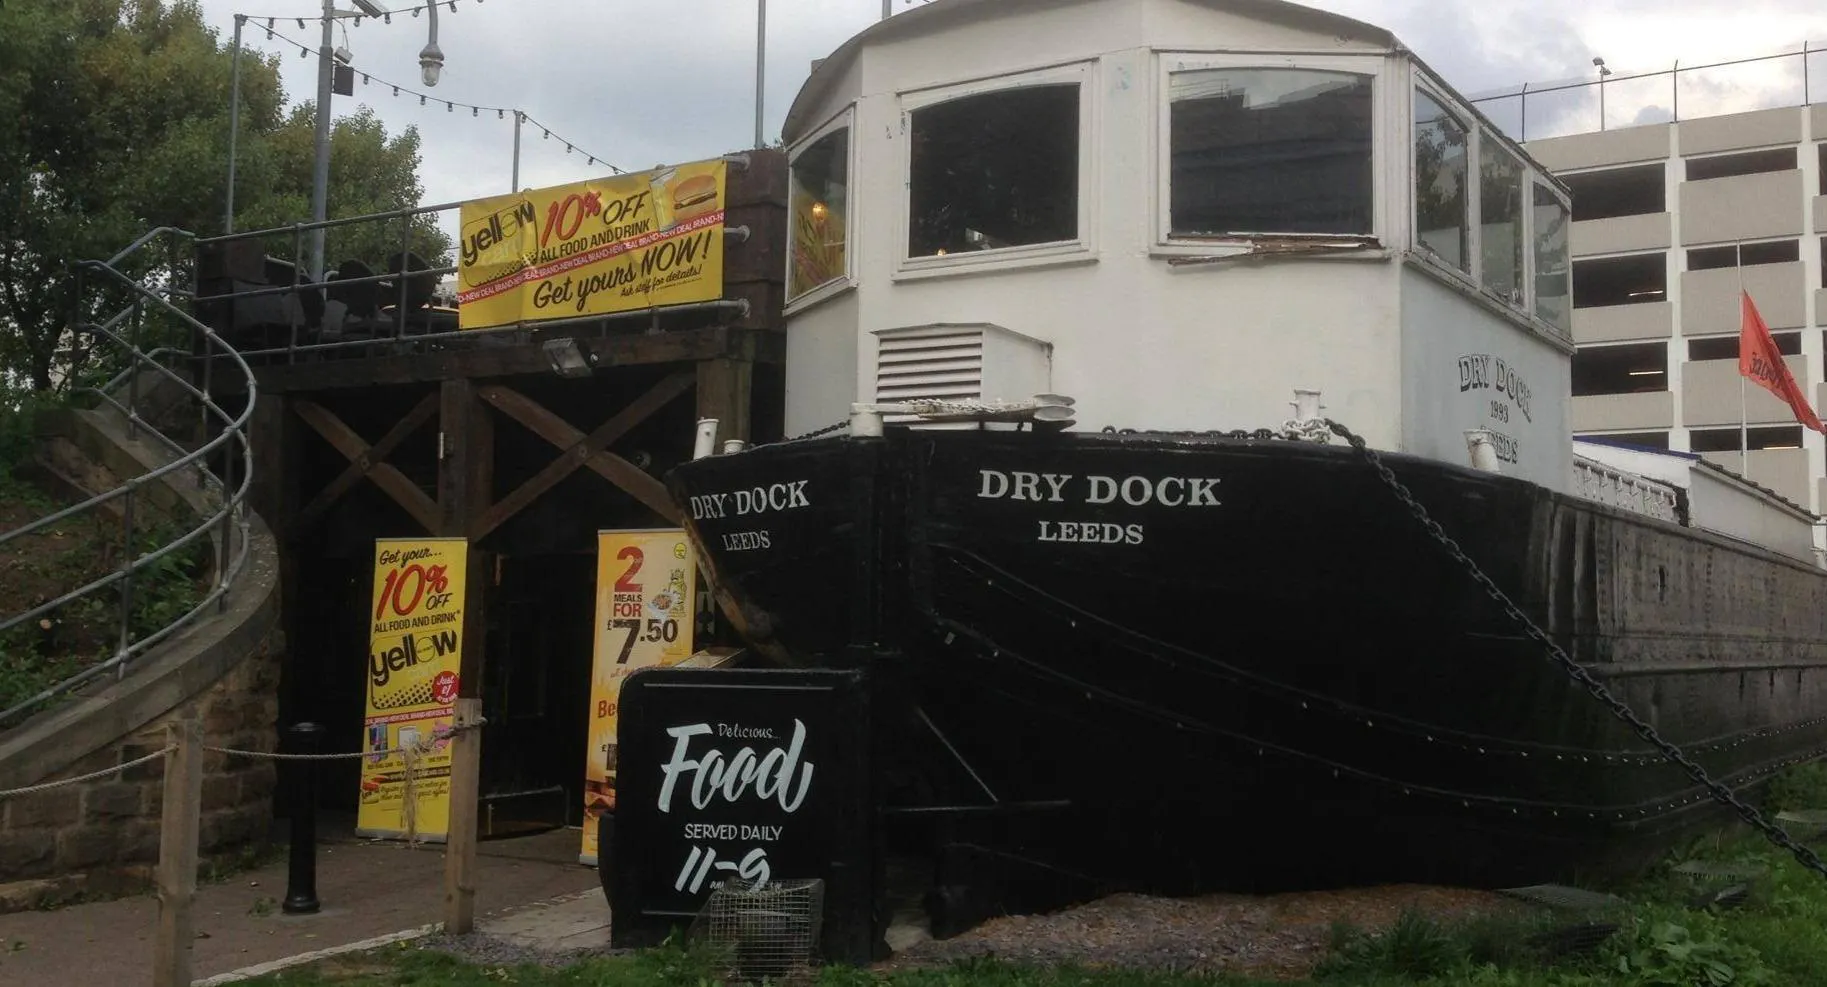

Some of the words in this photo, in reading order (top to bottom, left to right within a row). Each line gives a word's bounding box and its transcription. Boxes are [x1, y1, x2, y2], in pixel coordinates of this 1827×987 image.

[462, 201, 535, 267] yellow
[541, 191, 602, 248] 10%
[603, 190, 650, 225] OFF
[540, 247, 559, 263] ALL
[560, 237, 588, 257] FOOD
[590, 228, 614, 248] AND
[533, 276, 573, 308] Get
[577, 262, 637, 312] yours
[1458, 352, 1490, 393] DRY
[1490, 399, 1509, 424] 1993
[690, 493, 728, 520] DRY
[733, 480, 810, 515] DOCK
[977, 469, 1072, 502] DRY
[1085, 475, 1221, 507] DOCK
[722, 530, 771, 552] LEEDS
[1038, 521, 1144, 545] LEEDS
[379, 549, 400, 565] Get
[615, 546, 643, 592] 2
[376, 564, 448, 621] 10%
[426, 593, 453, 610] OFF
[613, 603, 642, 618] FOR
[614, 594, 642, 603] MEALS
[374, 622, 388, 634] ALL
[389, 618, 411, 632] FOOD
[411, 615, 430, 627] AND
[371, 630, 457, 687] yellow
[657, 718, 814, 813] Food
[684, 823, 738, 840] SERVED
[740, 825, 783, 841] DAILY
